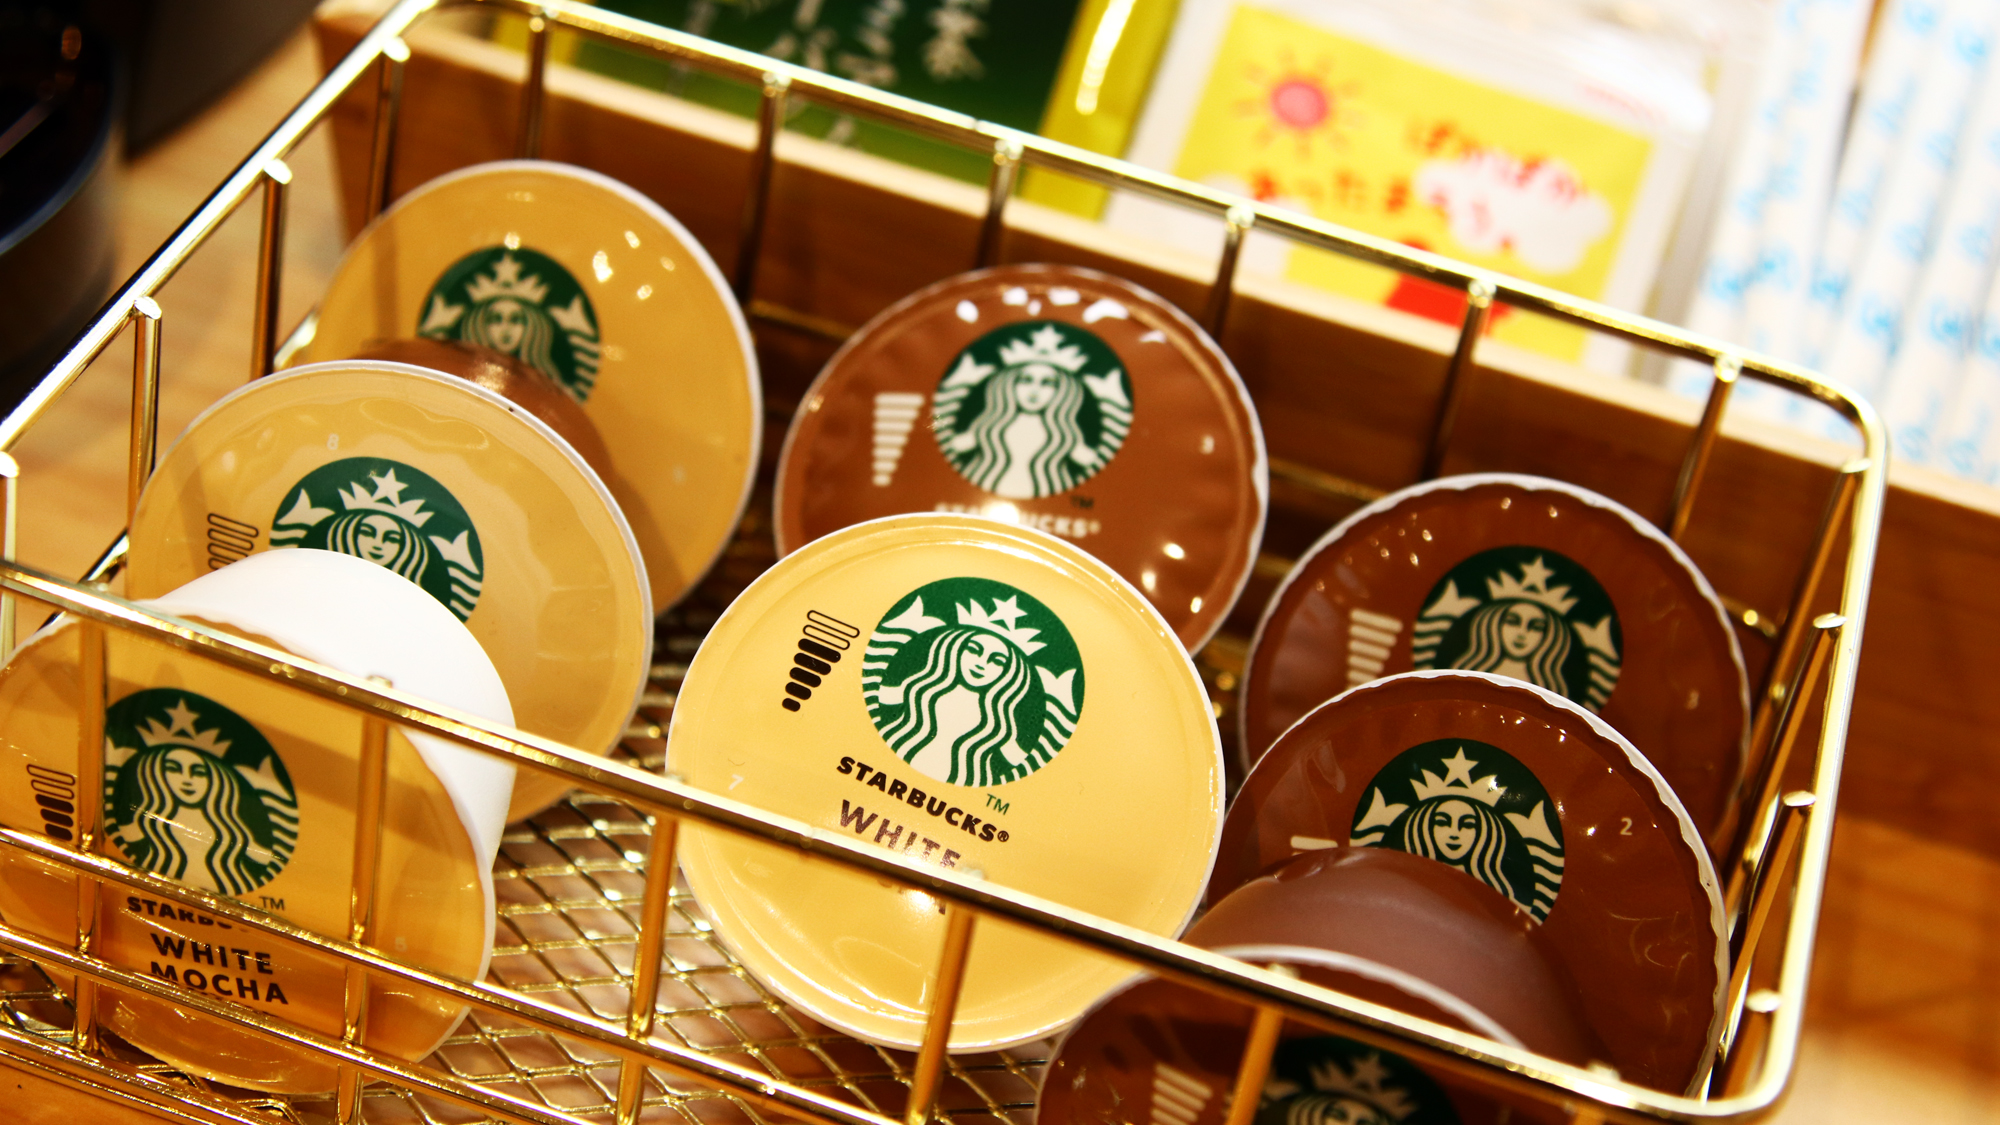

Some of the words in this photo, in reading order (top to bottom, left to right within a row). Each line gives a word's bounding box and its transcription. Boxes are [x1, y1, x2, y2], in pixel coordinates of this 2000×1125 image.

[326, 433, 339, 450] 8
[728, 774, 744, 790] 7
[985, 793, 1010, 816] TM
[1620, 817, 1632, 836] 2
[259, 896, 284, 910] TM
[150, 933, 273, 975] WHITE
[151, 961, 288, 1005] MOCHA
